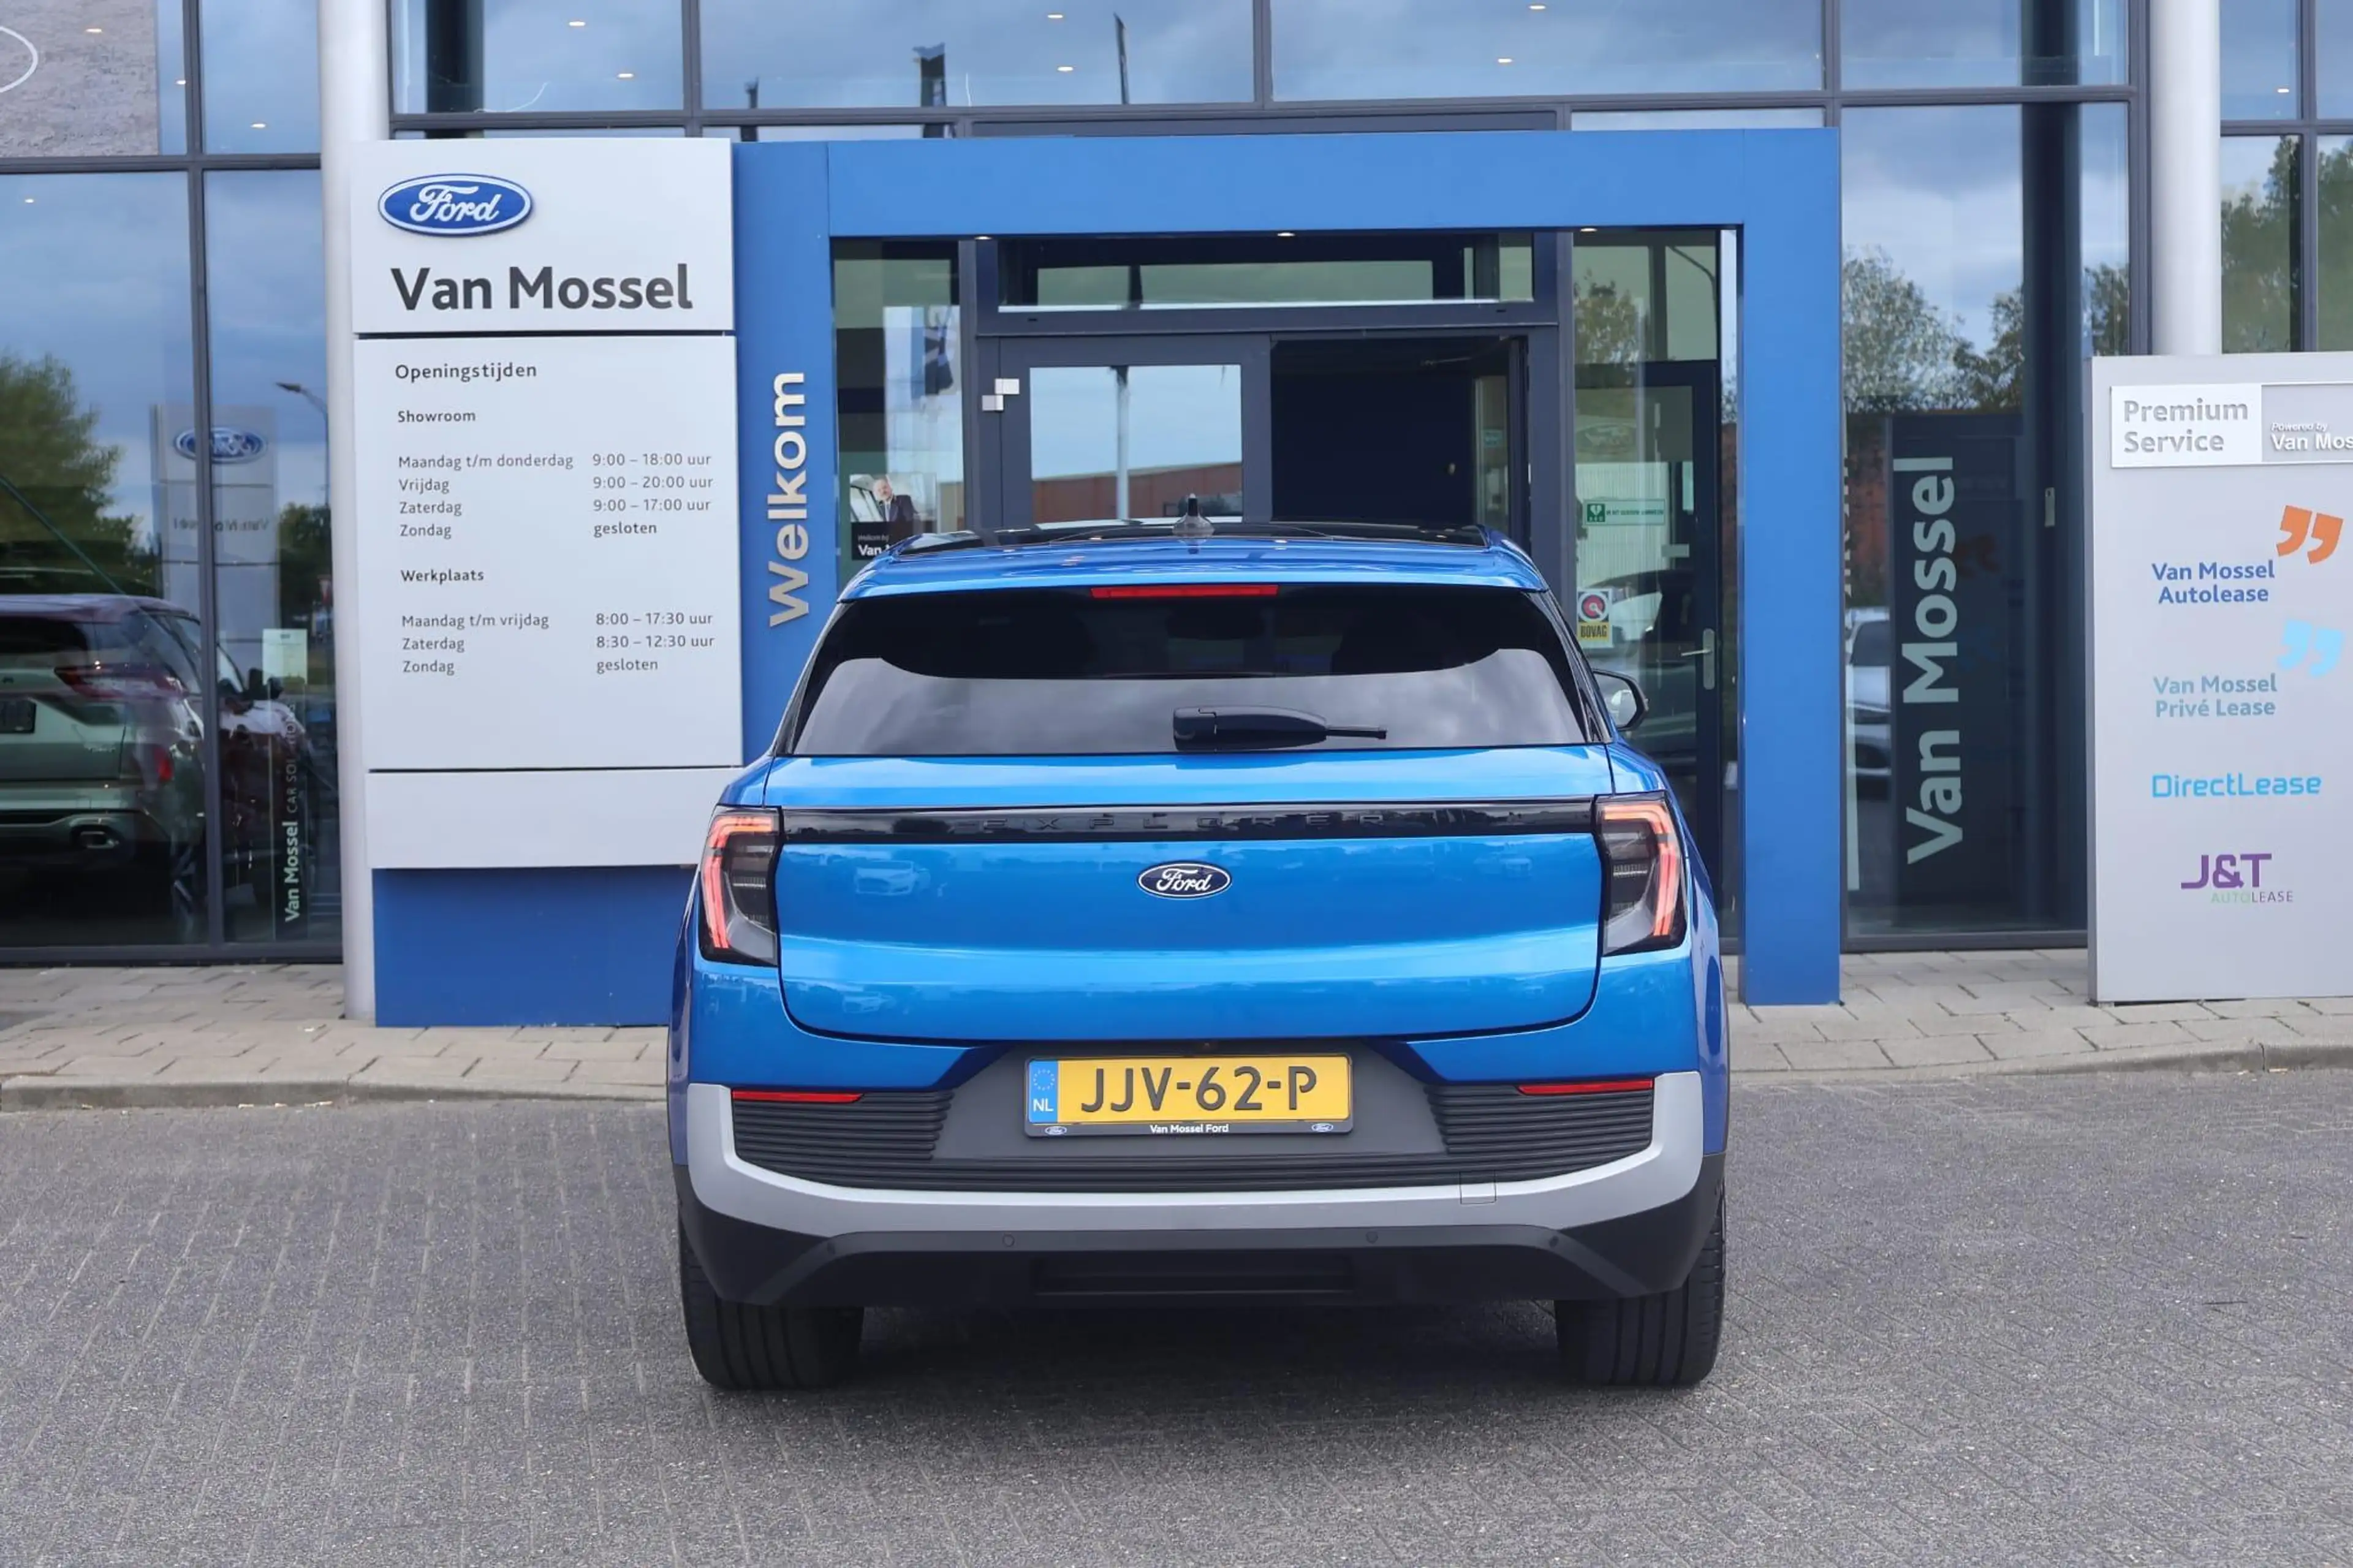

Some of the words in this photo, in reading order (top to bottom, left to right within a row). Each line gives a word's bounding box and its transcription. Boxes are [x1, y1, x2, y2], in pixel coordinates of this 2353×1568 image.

[409, 184, 502, 221] Ford
[390, 267, 492, 311] Van
[509, 263, 693, 309] Mossel
[395, 362, 536, 384] Openingstijden
[398, 410, 476, 423] Showroom
[2124, 398, 2248, 422] Premium
[2271, 422, 2314, 431] Powered
[2316, 422, 2328, 431] by
[2124, 429, 2224, 453] Service
[2271, 433, 2308, 450] Van
[399, 455, 461, 471] Maandag
[466, 454, 491, 468] t/m
[497, 452, 573, 469] donderdag
[593, 453, 625, 466] 9:00
[643, 453, 682, 465] 18:00
[688, 456, 711, 465] uur
[399, 478, 449, 494] Vrijdag
[593, 477, 626, 489] 9:00
[643, 476, 684, 488] 20:00
[690, 479, 713, 488] uur
[400, 501, 461, 517] Zaterdag
[594, 499, 626, 512] 9:00
[643, 499, 682, 510] 17:00
[688, 501, 711, 510] uur
[767, 373, 809, 627] Welkom
[400, 523, 452, 540] Zondag
[594, 521, 657, 538] gesloten
[858, 544, 882, 556] Van
[401, 569, 484, 585] Werkplaats
[1893, 456, 1960, 703] Mossel
[2151, 562, 2192, 581] Van
[2199, 559, 2275, 580] Mossel
[2158, 584, 2269, 604] Autolease
[402, 614, 465, 630] Maandag
[470, 614, 495, 626] t/m
[500, 613, 549, 629] vrijdag
[596, 613, 629, 625] 8:00
[646, 612, 684, 624] 17:30
[689, 615, 713, 624] uur
[1581, 625, 1607, 638] BOVAG
[403, 637, 464, 653] Zaterdag
[596, 635, 629, 648] 8:30
[646, 635, 686, 648] 12:30
[691, 637, 715, 646] uur
[403, 660, 455, 676] Zondag
[597, 658, 658, 675] gesloten
[2153, 676, 2194, 694] Van
[2201, 673, 2278, 694] Mossel
[2156, 698, 2210, 718] Privé
[2216, 699, 2276, 717] Lease
[2152, 773, 2322, 797] DirectLease
[286, 787, 298, 813] CAR
[1906, 730, 1963, 865] Van
[282, 821, 299, 884] Mossel
[1156, 868, 1213, 891] Ford
[2181, 853, 2272, 889] J&T
[285, 888, 300, 922] Van
[2211, 890, 2294, 904] AUTOLEASE
[1081, 1066, 1317, 1113] JJV-62-P
[1033, 1098, 1054, 1112] NL
[1170, 1124, 1203, 1132] Mossel
[1206, 1124, 1229, 1132] Ford
